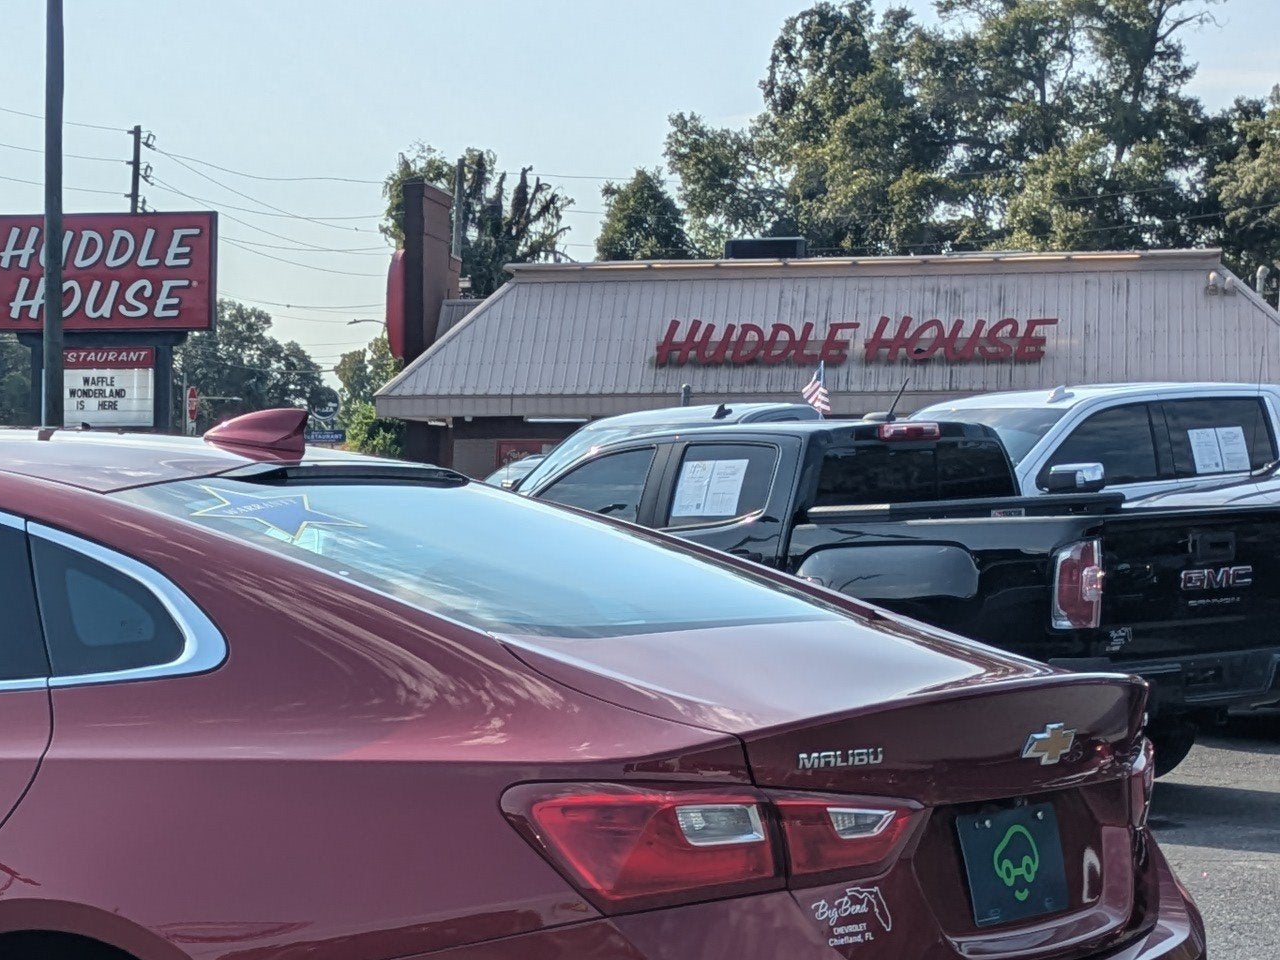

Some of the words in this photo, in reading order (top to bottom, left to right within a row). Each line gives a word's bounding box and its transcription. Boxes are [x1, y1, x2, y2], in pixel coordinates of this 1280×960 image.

[0, 226, 201, 269] HUDDLE
[8, 277, 191, 319] HOUSE
[656, 318, 860, 365] HUDDLE
[864, 315, 1058, 362] HOUSE
[63, 351, 148, 362] STAURANT
[82, 376, 115, 387] WAFFLE
[68, 388, 127, 399] WONDERLAND
[76, 400, 85, 411] IS
[97, 400, 119, 411] HERE
[1181, 565, 1253, 590] GMC
[799, 748, 883, 769] MALIBU
[812, 899, 838, 926] Big
[834, 896, 869, 917] Bend
[833, 922, 867, 935] CHEVROLET
[865, 932, 874, 941] FL
